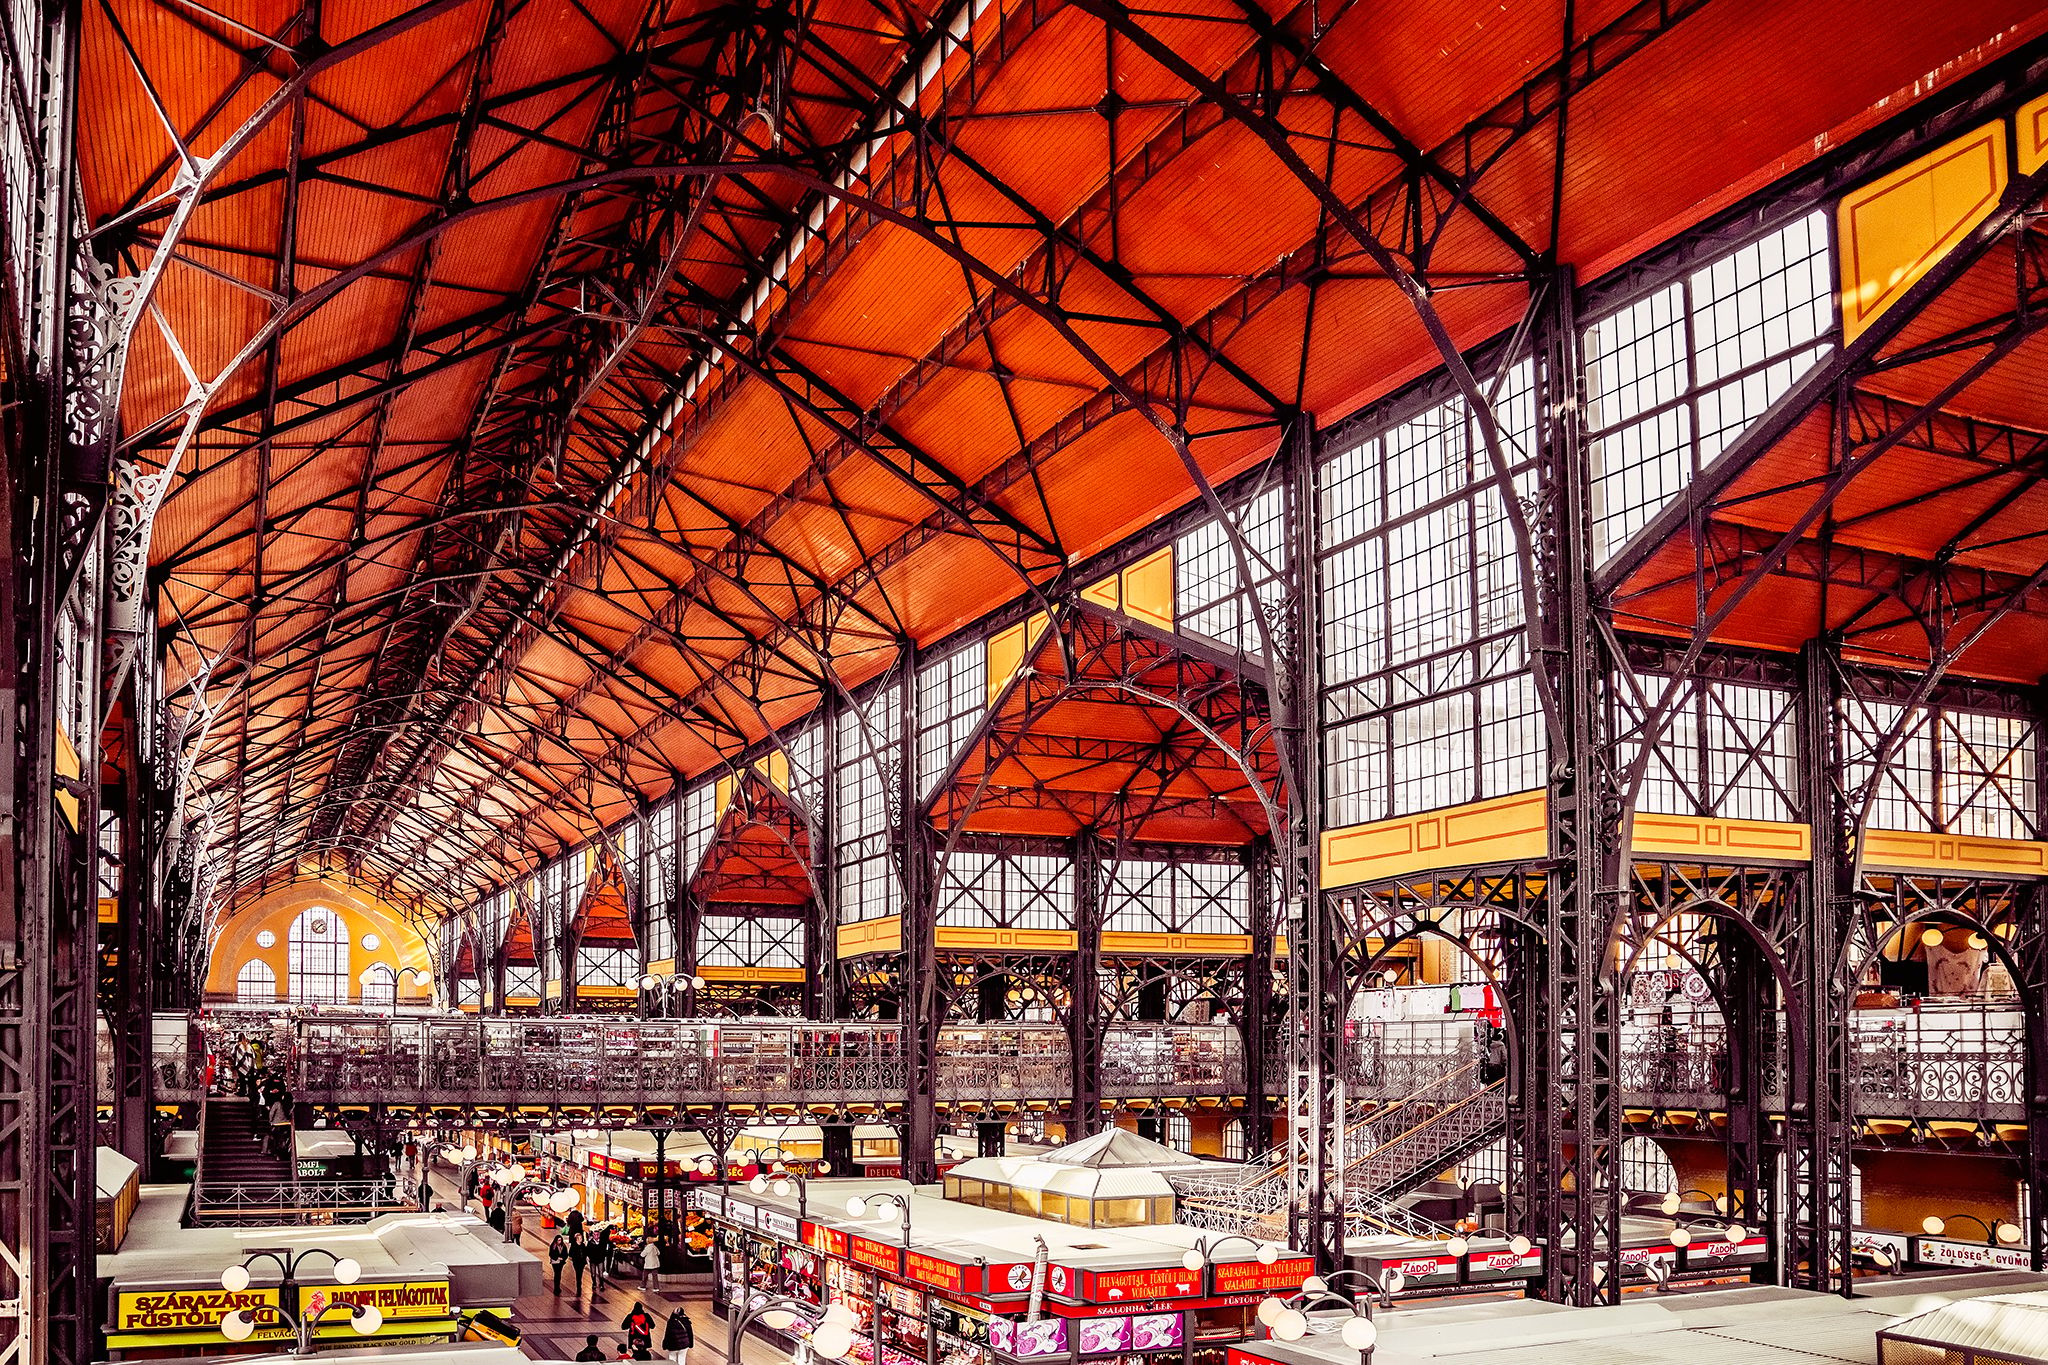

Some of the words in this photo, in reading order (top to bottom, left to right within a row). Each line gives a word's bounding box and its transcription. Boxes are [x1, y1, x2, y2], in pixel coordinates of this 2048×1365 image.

[643, 1166, 668, 1174] TOJS
[1403, 1261, 1437, 1274] ZÁDOR
[1489, 1255, 1520, 1267] ZÁDOR
[135, 1291, 265, 1311] SZÁRAZÁRU
[378, 1283, 447, 1307] FELVÁGOTTAK
[126, 1309, 273, 1328] FÜSTÖLTRU
